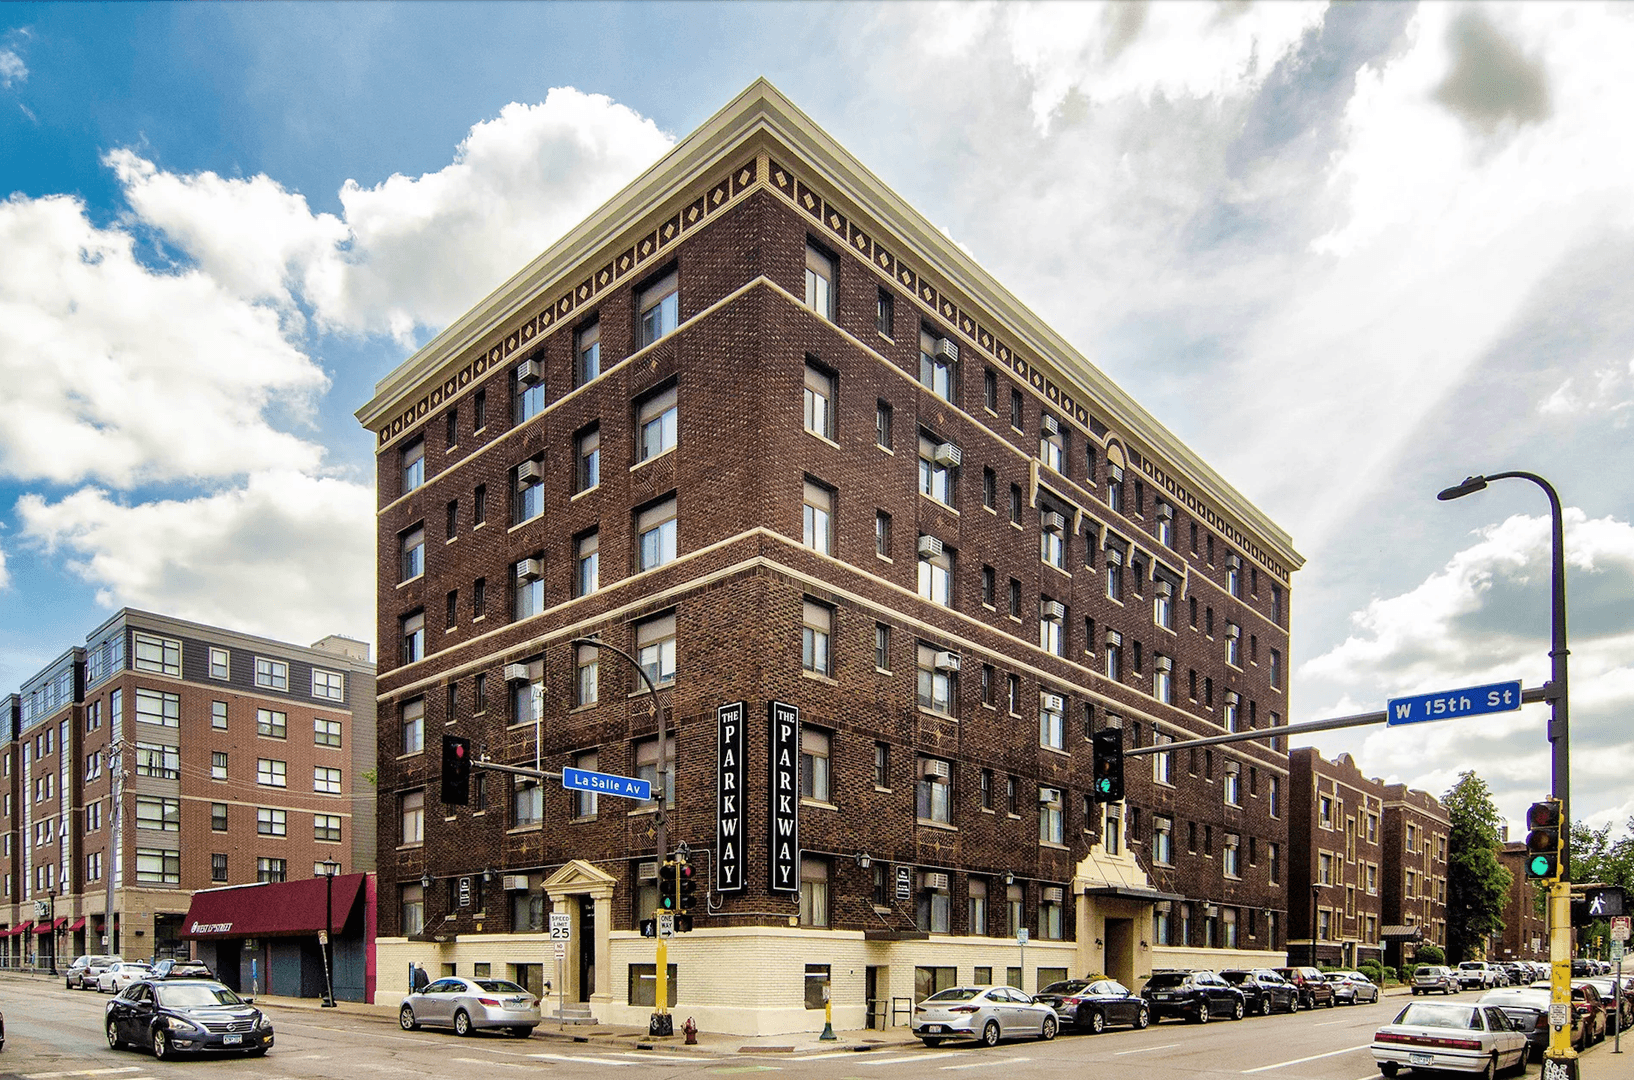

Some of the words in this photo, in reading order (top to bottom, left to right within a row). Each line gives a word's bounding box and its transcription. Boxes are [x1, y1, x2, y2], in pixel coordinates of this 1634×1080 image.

[1395, 703, 1412, 719] W
[1425, 696, 1471, 716] 15th
[1487, 689, 1512, 706] St
[721, 710, 739, 724] THE
[777, 709, 795, 724] THE
[625, 782, 641, 794] Av
[721, 725, 738, 883] PARKWAY
[777, 724, 794, 883] PARKWAY
[552, 927, 570, 939] 25
